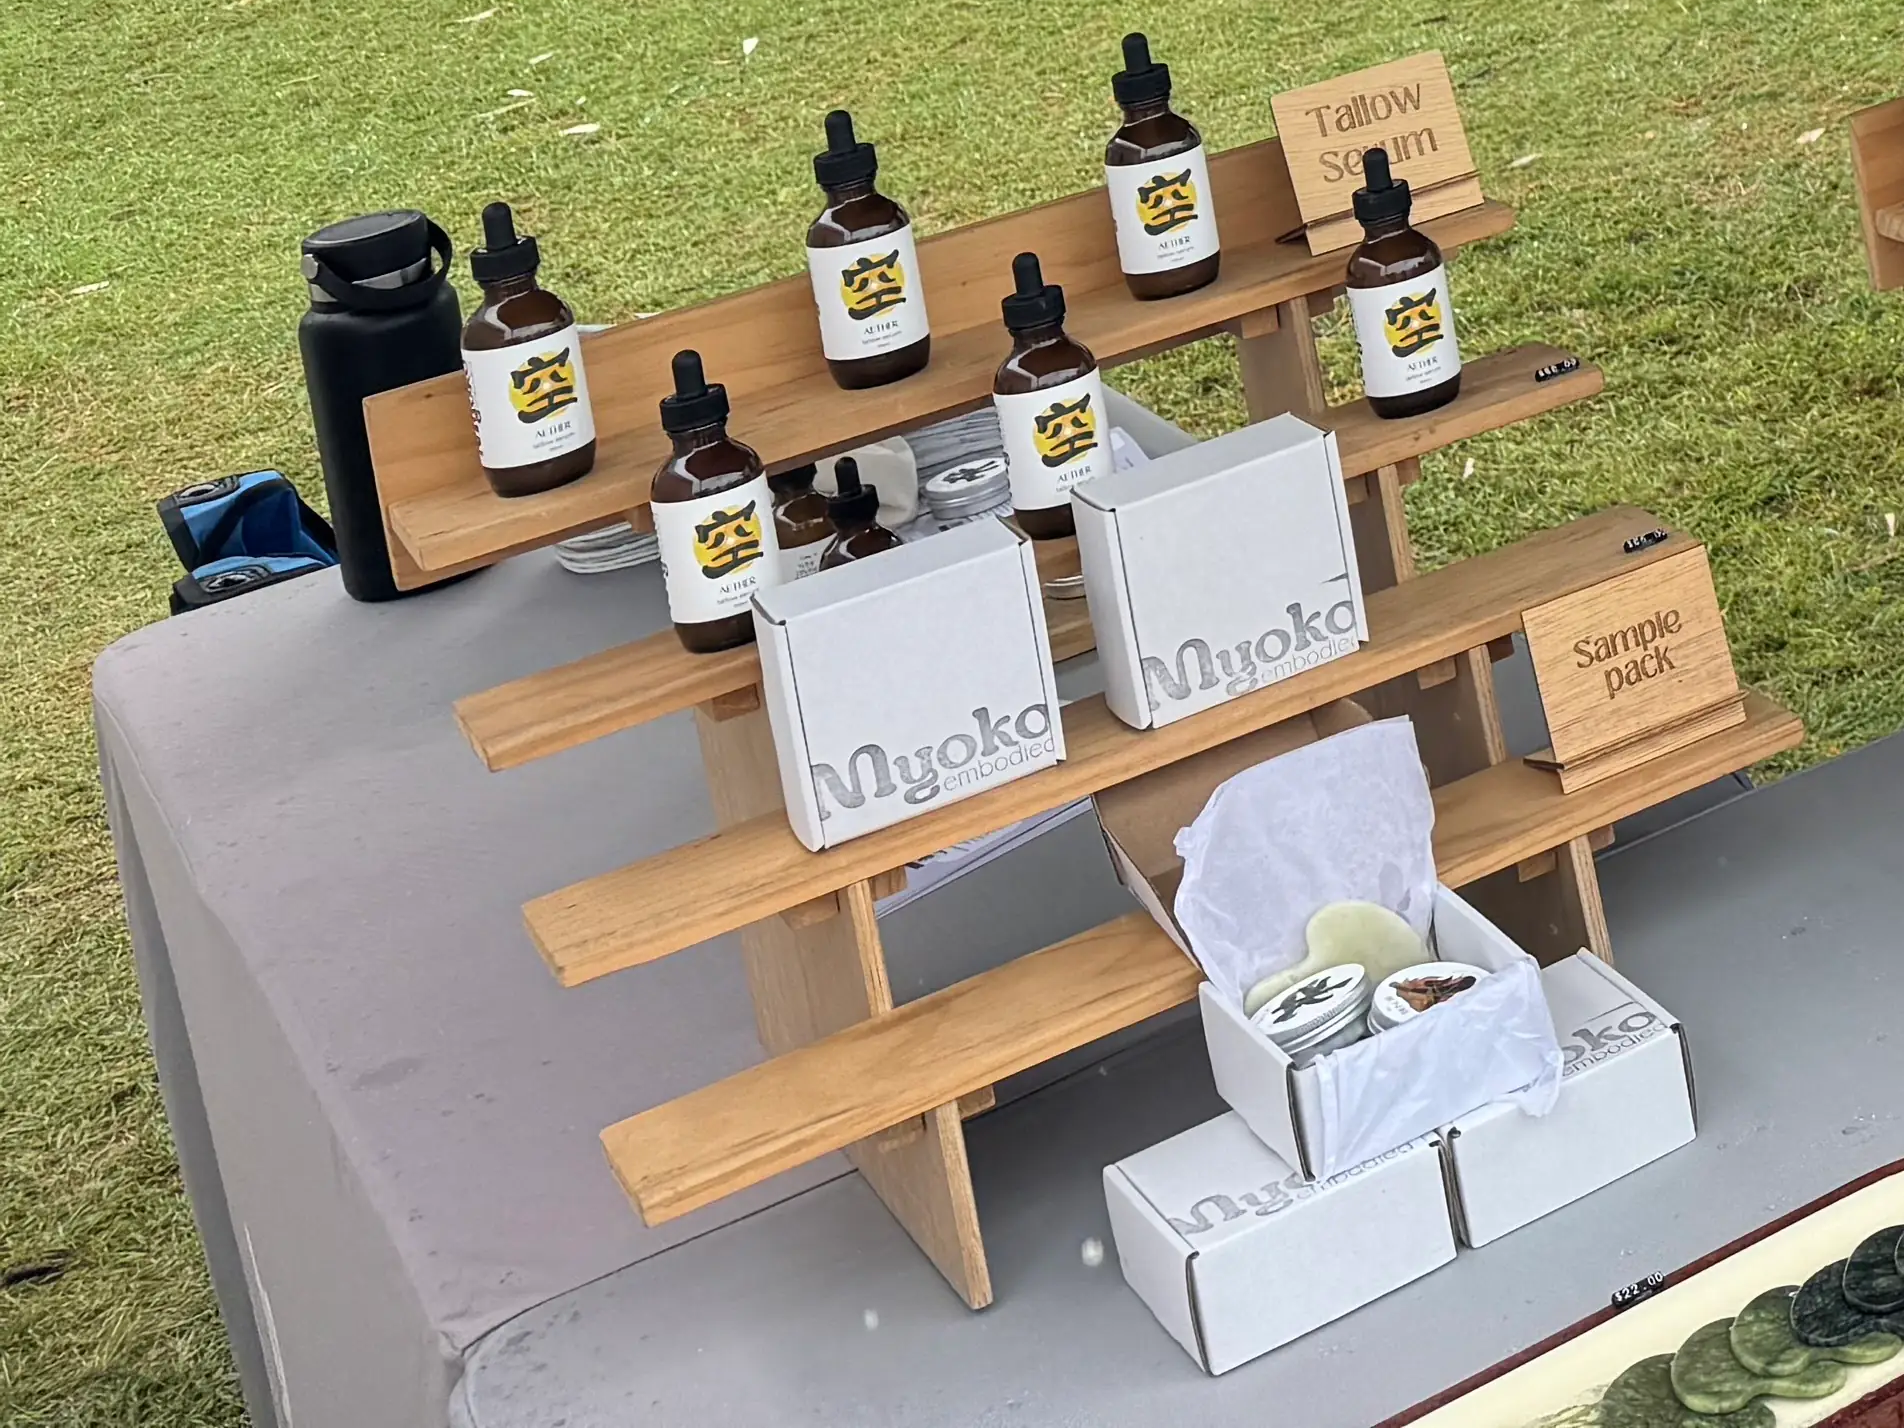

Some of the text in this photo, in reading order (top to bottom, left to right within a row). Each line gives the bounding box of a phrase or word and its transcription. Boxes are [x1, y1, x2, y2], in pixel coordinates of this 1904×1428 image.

[1305, 83, 1421, 138] Tallow
[1573, 609, 1682, 668] Sample
[1604, 646, 1675, 700] pack
[1615, 1271, 1664, 1302] $22.00
